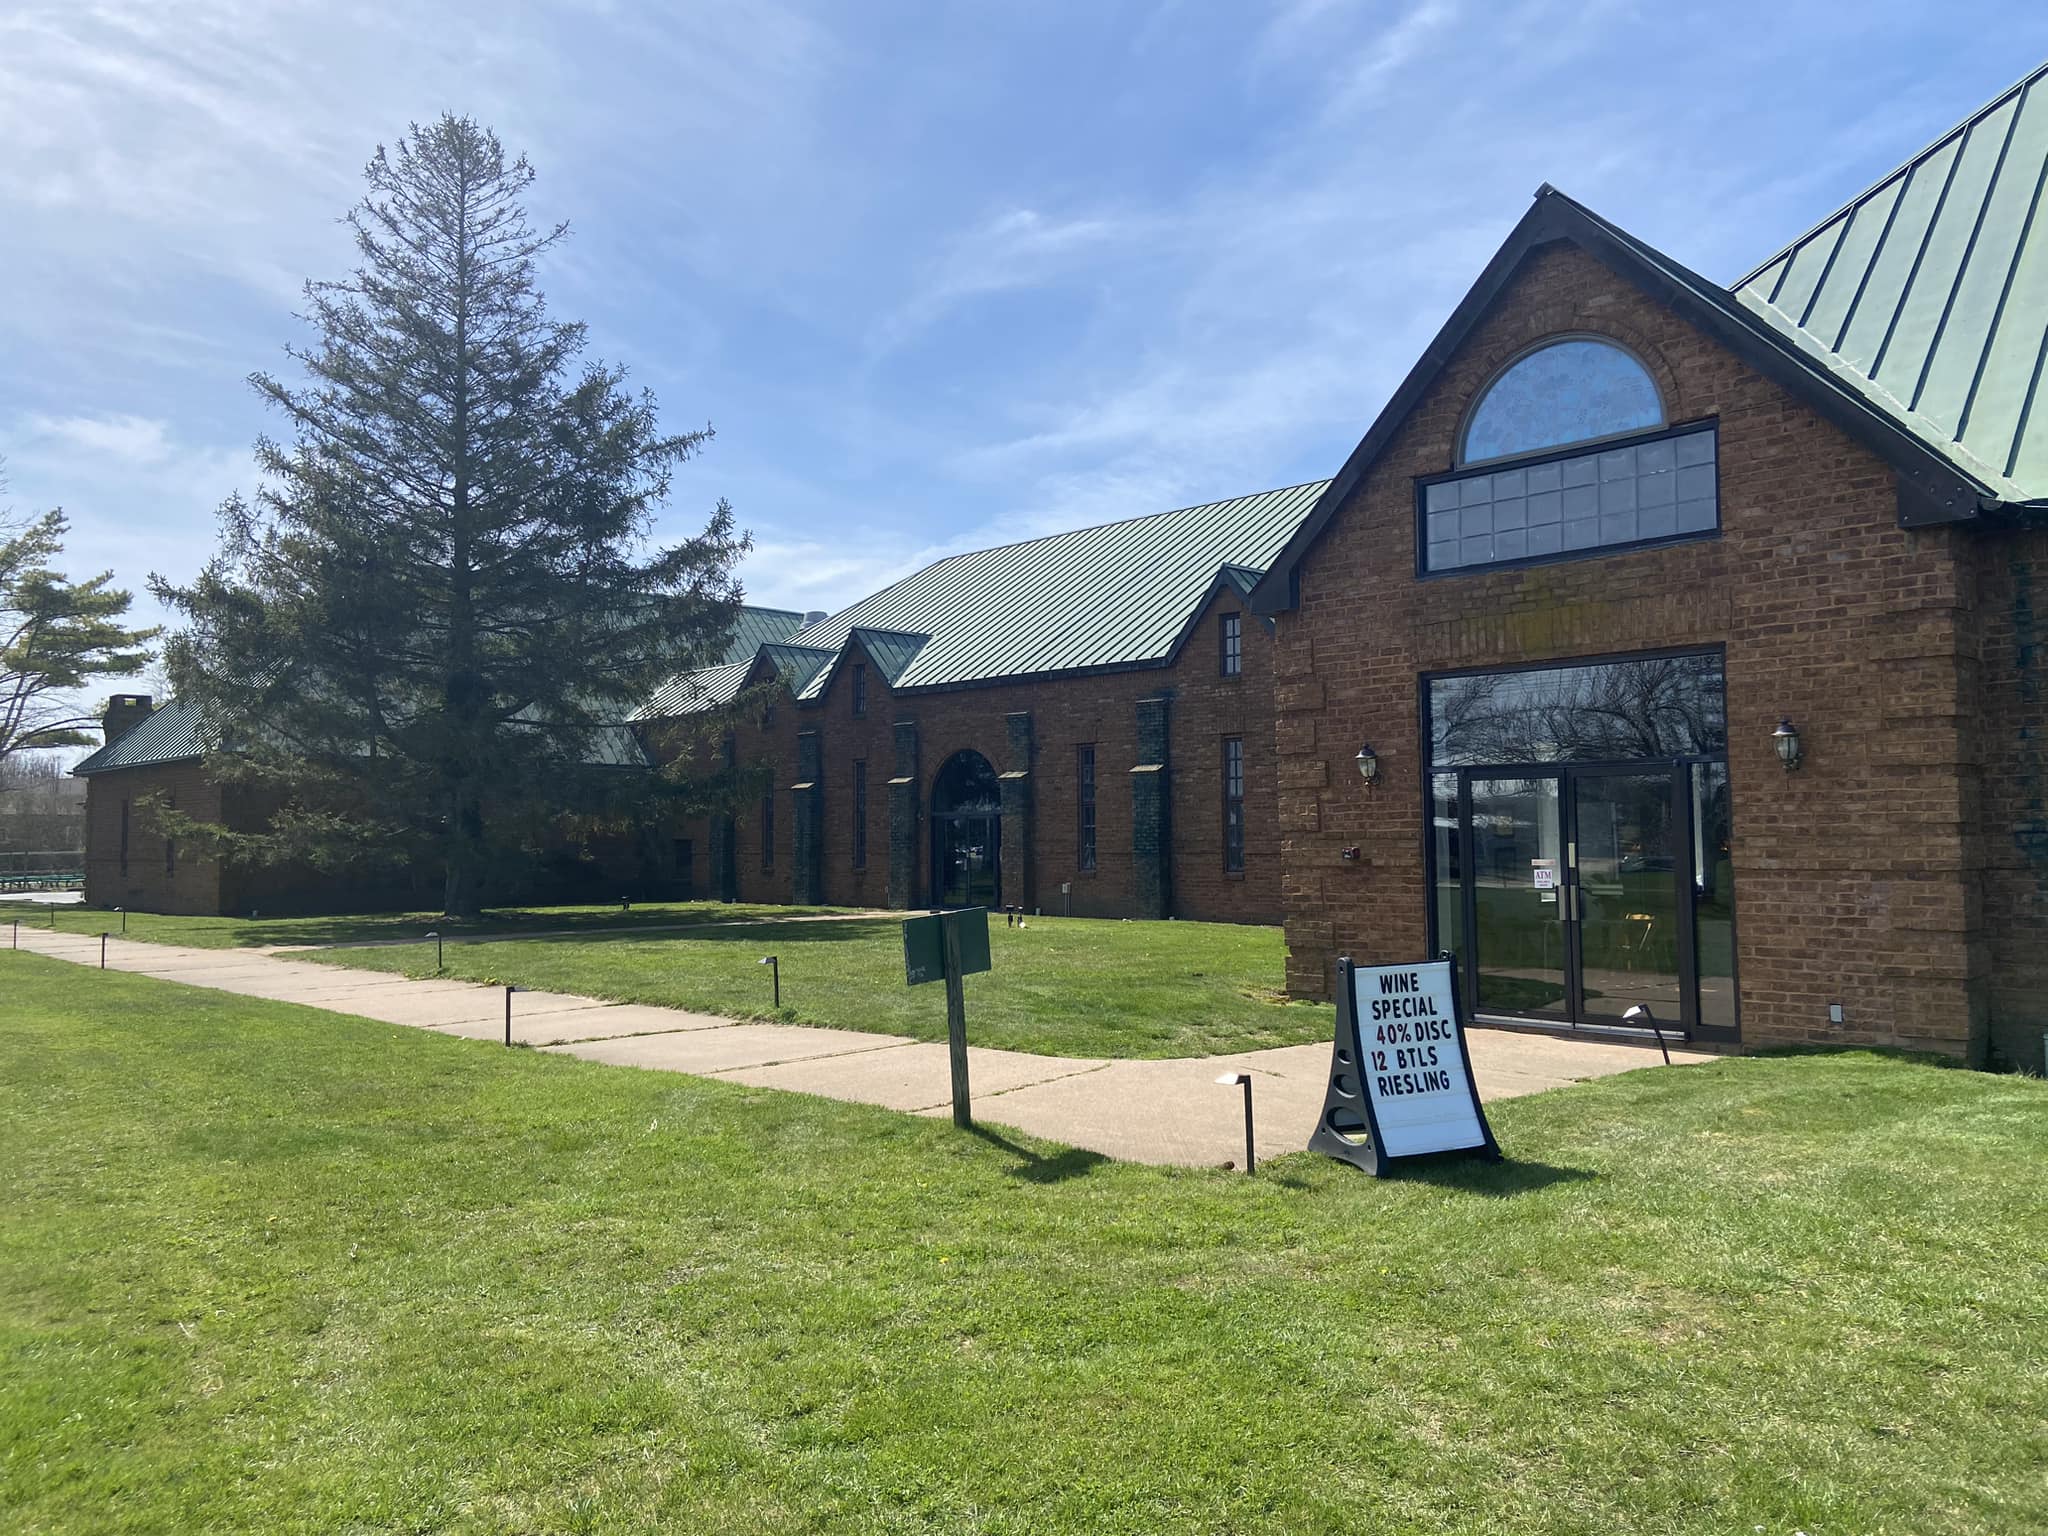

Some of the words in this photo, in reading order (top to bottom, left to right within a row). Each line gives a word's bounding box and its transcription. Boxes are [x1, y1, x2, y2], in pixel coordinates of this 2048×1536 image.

[1536, 871, 1552, 879] ATM
[1379, 972, 1419, 994] WINE
[1372, 996, 1437, 1020] SPECIAL
[1376, 1023, 1412, 1045] 40%
[1415, 1019, 1451, 1042] DISC
[1371, 1050, 1388, 1071] 12
[1397, 1046, 1438, 1069] BTLS
[1377, 1070, 1450, 1097] RIESLING
